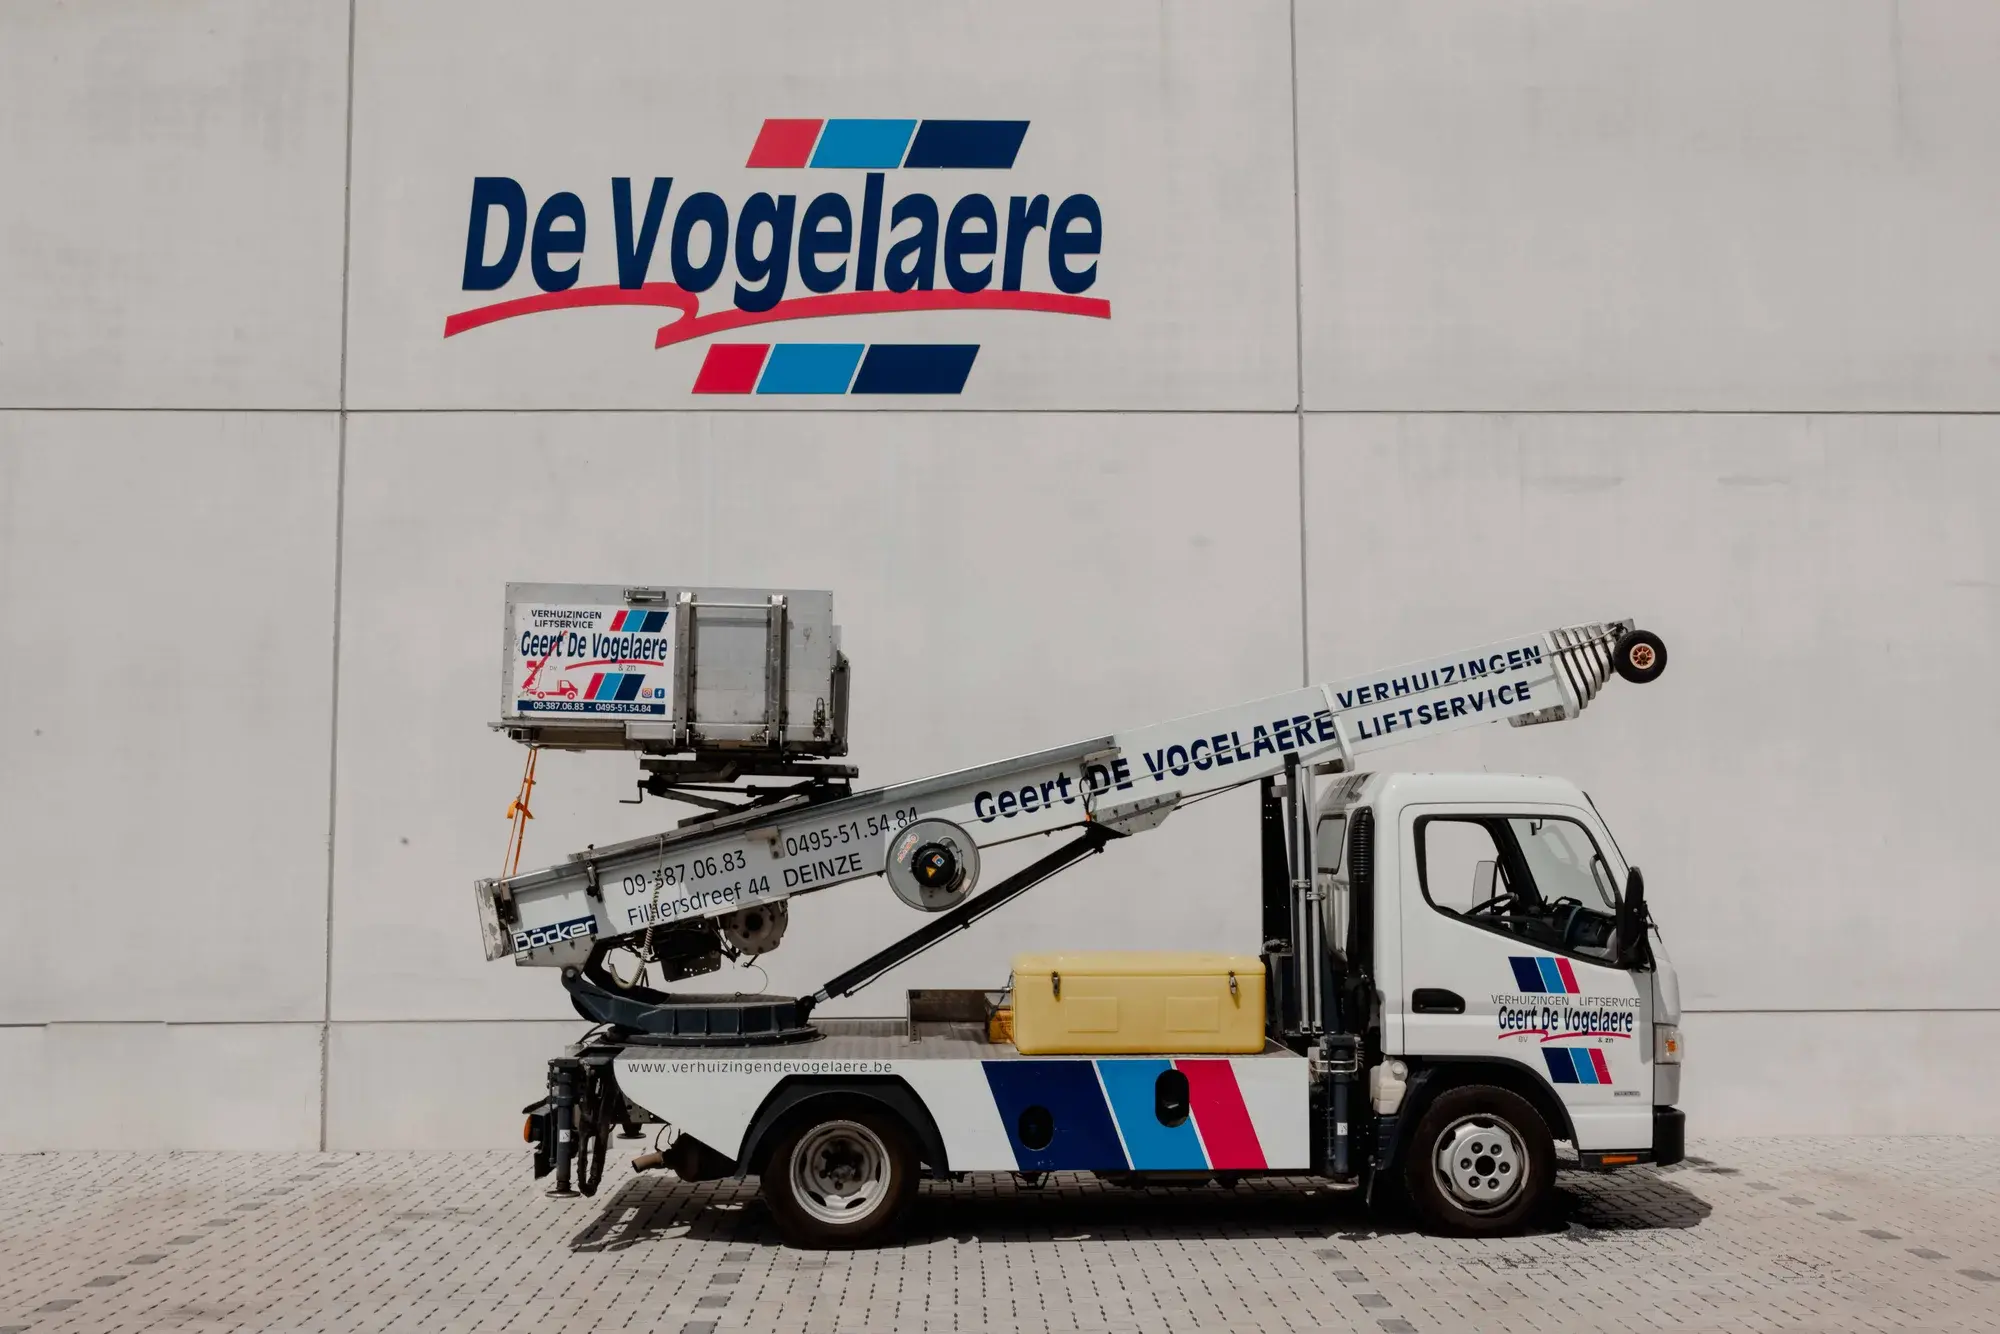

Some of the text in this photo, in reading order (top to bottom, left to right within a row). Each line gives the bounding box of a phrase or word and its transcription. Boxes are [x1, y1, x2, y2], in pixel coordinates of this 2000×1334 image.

[462, 172, 1103, 313] De Vogelaere
[531, 609, 602, 620] VERHUIZINGEN
[534, 619, 594, 629] LIFTSERVICE
[521, 630, 668, 663] Geert De Vogelaere
[618, 663, 637, 672] & zn
[1336, 645, 1543, 709] VERHUIZINGEN
[533, 701, 585, 711] 09-387.06.83
[595, 703, 652, 713] 0495-51.54.84
[1357, 680, 1532, 740] LIFTSERVICE
[974, 709, 1337, 823] Geert DE VOGELAERE
[786, 806, 919, 857] 0495-51.54.84
[748, 875, 771, 896] 44
[783, 852, 863, 888] DEINZE
[1491, 994, 1641, 1008] VERHUIZINGEN LIFTSERVICE
[1499, 1005, 1633, 1036] Geert De Vogelaere
[628, 1060, 892, 1075] www.verhuizingendevogelaere.be
